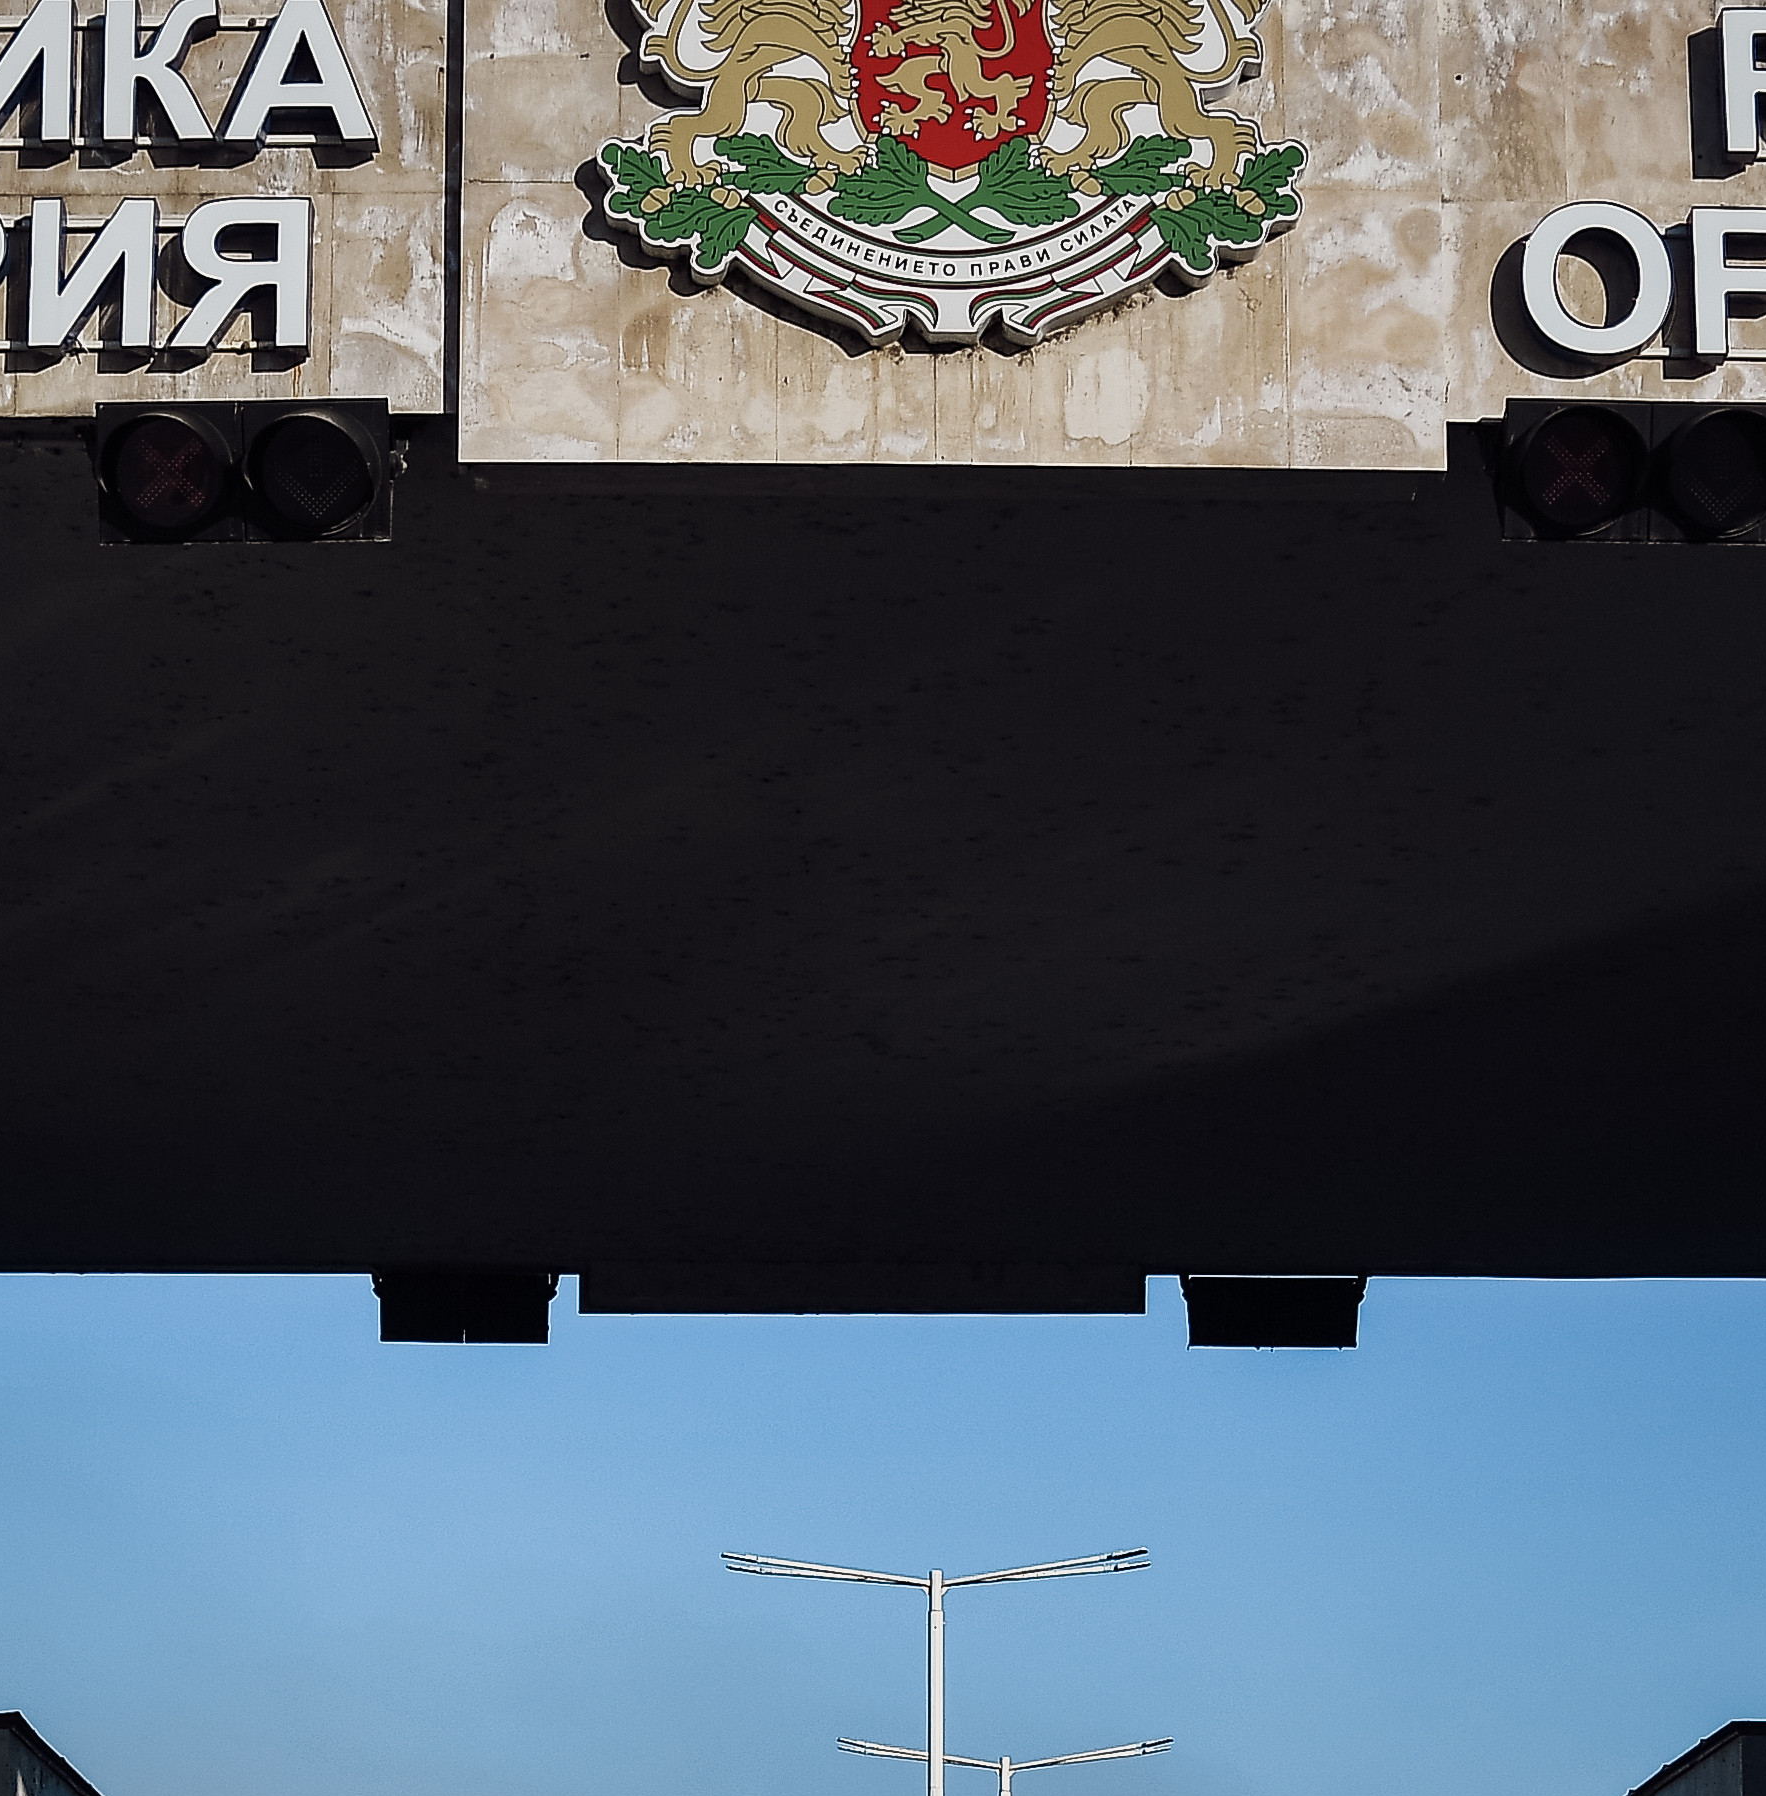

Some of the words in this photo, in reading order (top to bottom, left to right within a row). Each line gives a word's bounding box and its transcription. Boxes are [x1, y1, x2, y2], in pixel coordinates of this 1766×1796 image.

[774, 199, 956, 277] СЪЕДИНЕНИЕТО
[970, 248, 1051, 277] ПРАВИ
[1060, 199, 1137, 252] СИЛАТА
